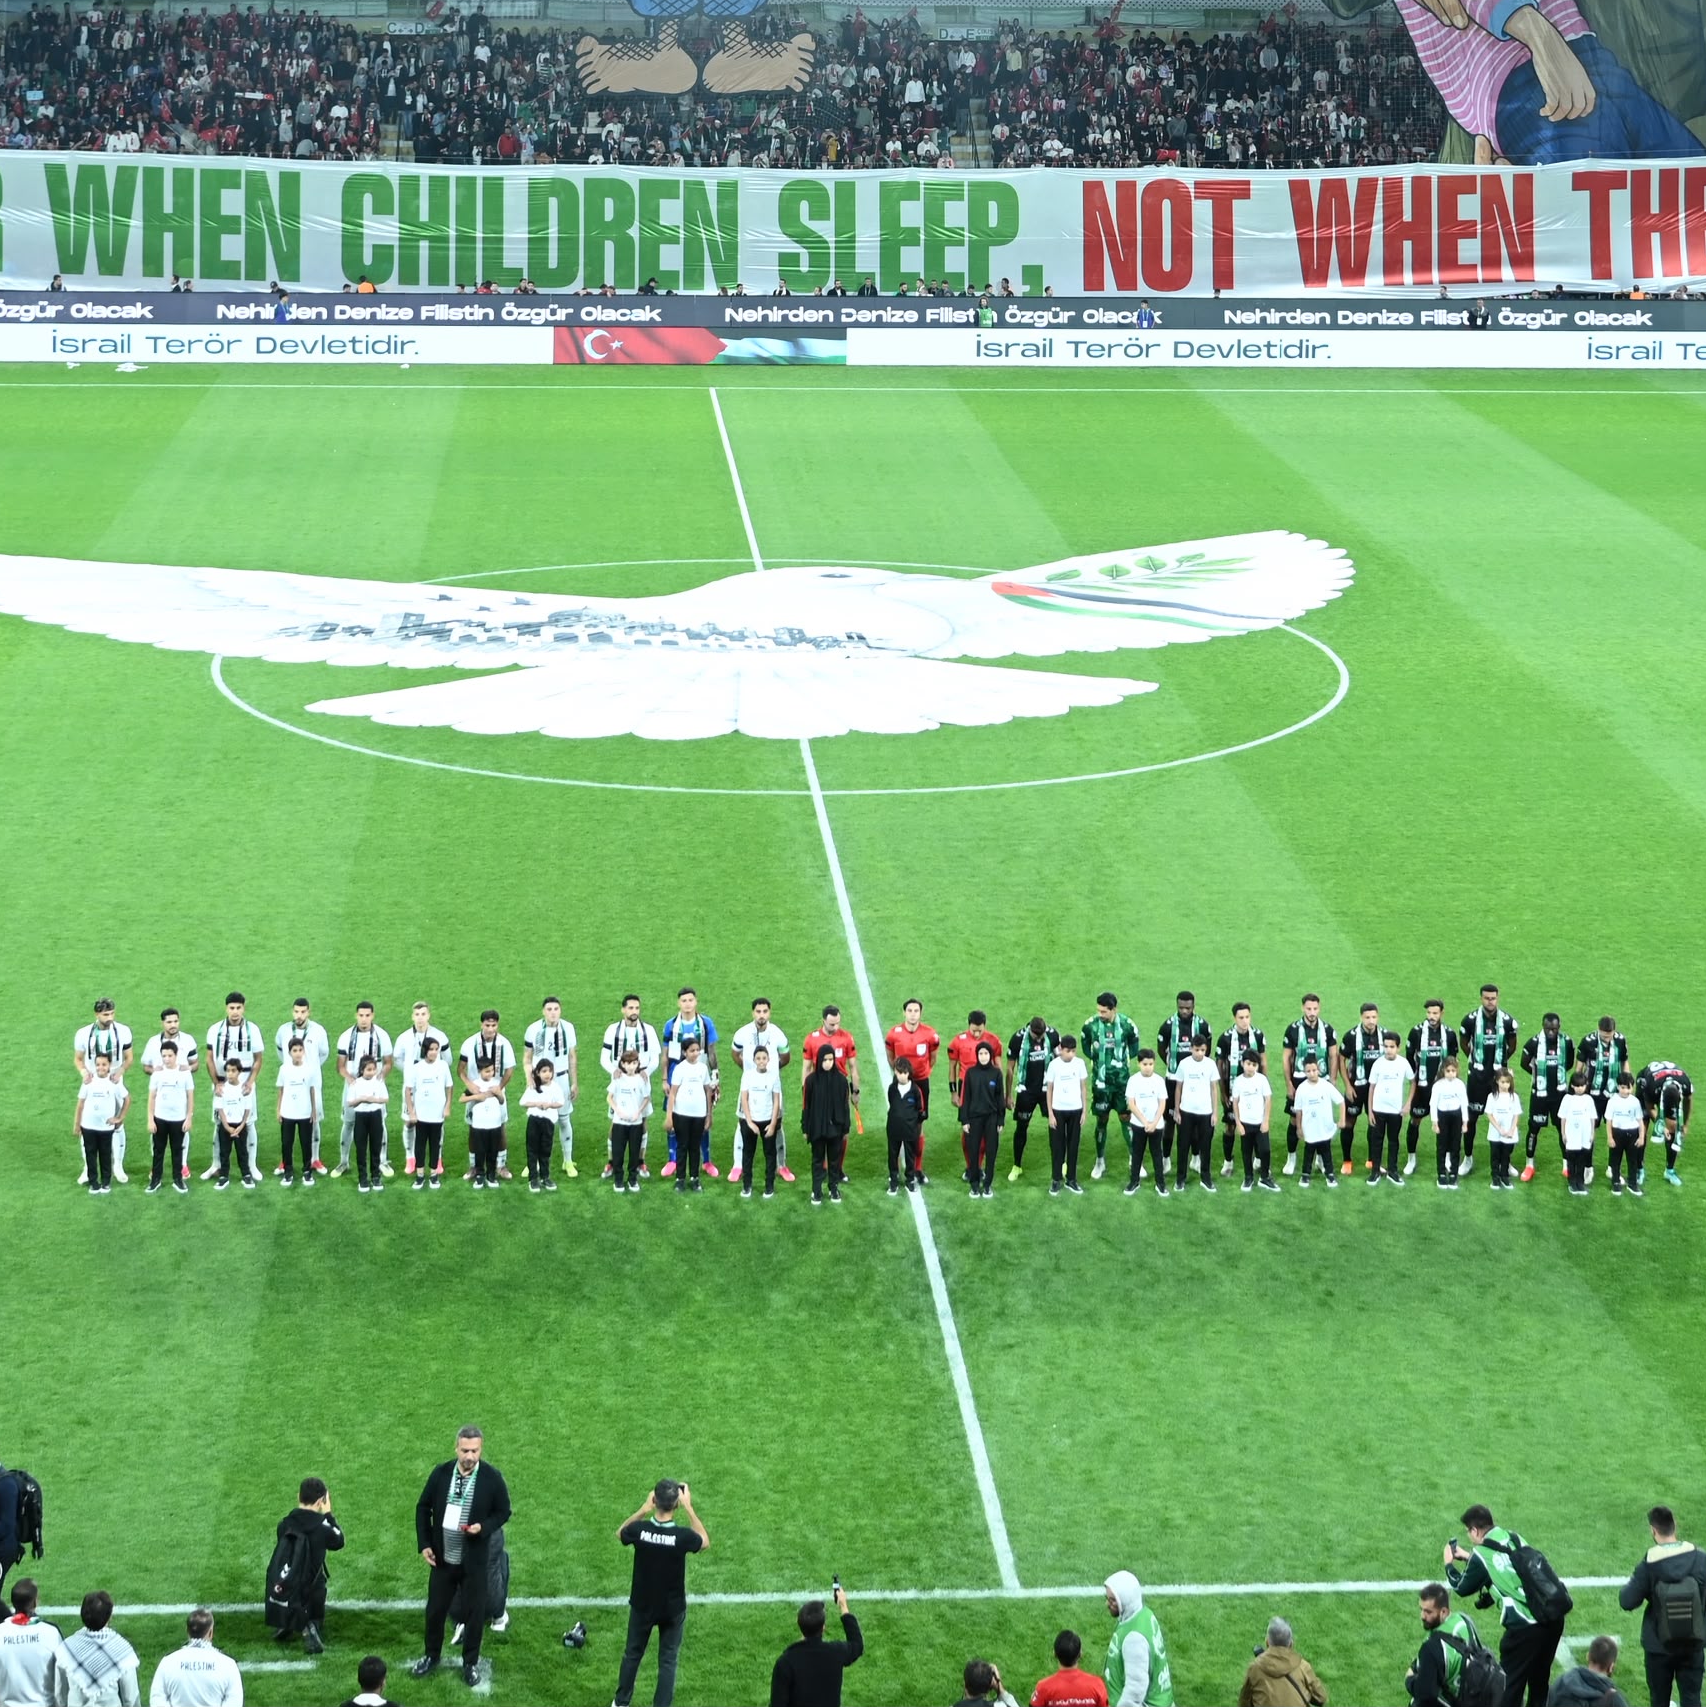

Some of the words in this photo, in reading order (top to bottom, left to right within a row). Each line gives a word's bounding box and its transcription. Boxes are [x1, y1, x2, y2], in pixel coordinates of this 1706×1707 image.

[44, 161, 300, 284] WHEN
[339, 171, 741, 291] CHILDREN
[1081, 177, 1252, 293] NOT
[1289, 171, 1540, 289] WHEN
[70, 301, 154, 319] Olacak
[334, 303, 414, 320] Denize
[420, 304, 495, 321] Filistin
[501, 302, 574, 325] Özgür
[580, 305, 662, 322] Olacak
[724, 306, 834, 323] Nehirden
[841, 306, 919, 323] Denize
[1004, 304, 1076, 327] Özgür
[1224, 308, 1331, 325] Nehirden
[1337, 309, 1414, 325] Denize
[1497, 307, 1568, 329] Özgür
[1574, 309, 1653, 326] Olacak
[145, 333, 242, 355] Terör
[256, 334, 418, 355] Devletidir.
[1066, 337, 1161, 359] Terör
[1173, 339, 1331, 359] Devletidir.
[640, 1529, 677, 1547] PALESTINE
[3, 1633, 41, 1646] PALESTINE
[180, 1661, 217, 1672] PALESTINE
